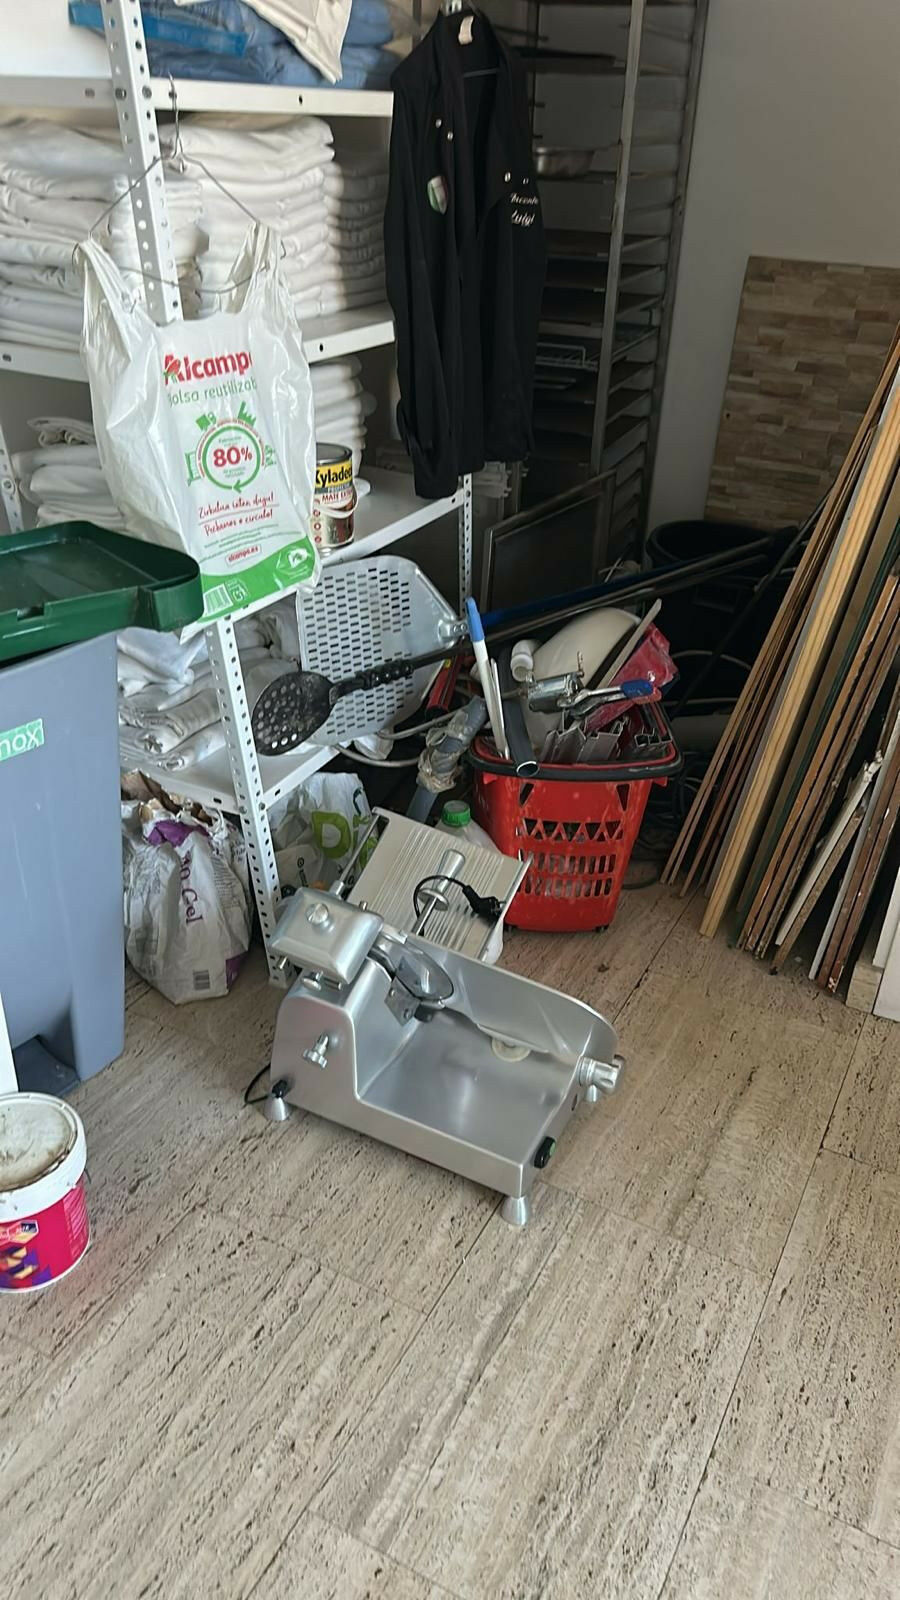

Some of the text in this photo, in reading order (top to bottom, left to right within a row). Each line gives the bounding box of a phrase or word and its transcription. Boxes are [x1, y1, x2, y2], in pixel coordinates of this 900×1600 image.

[163, 350, 253, 386] Alcamp
[167, 388, 199, 408] olsa
[213, 445, 253, 468] 80%
[181, 888, 204, 925] Gel
